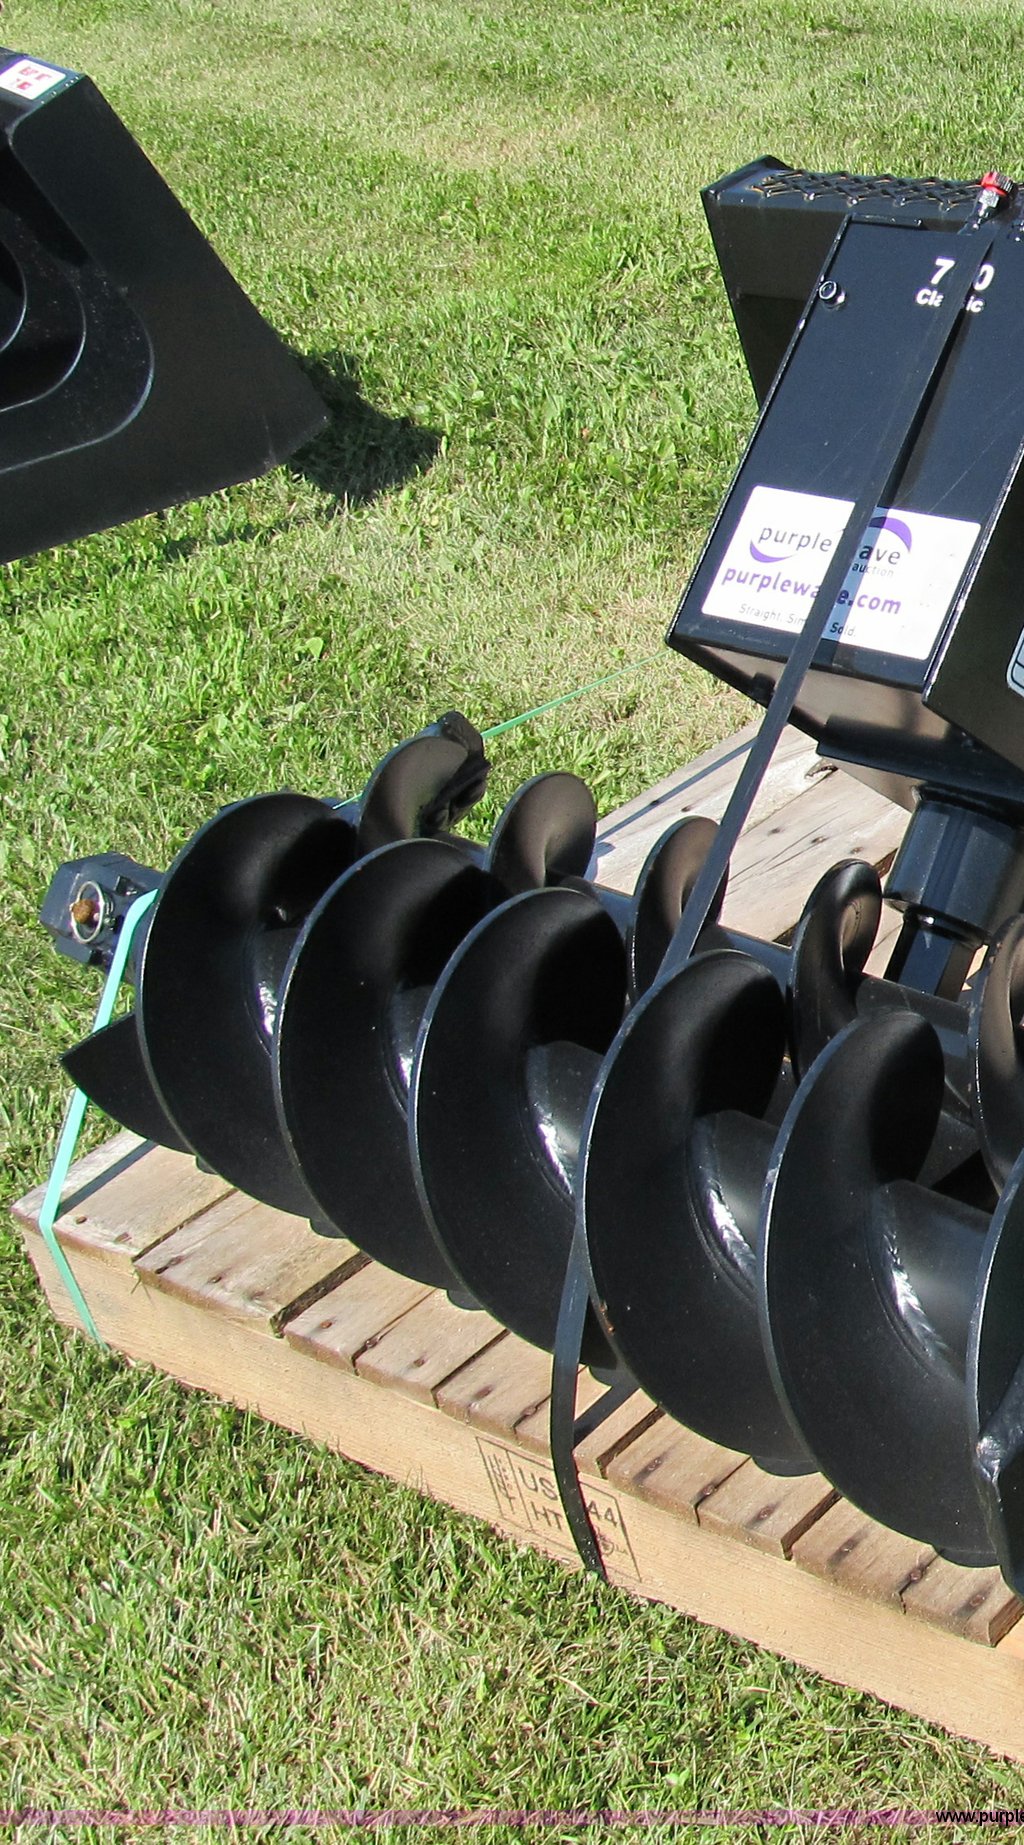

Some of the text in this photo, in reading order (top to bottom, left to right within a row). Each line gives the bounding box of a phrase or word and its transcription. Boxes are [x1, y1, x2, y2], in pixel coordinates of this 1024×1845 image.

[930, 257, 995, 291] 70
[915, 288, 984, 313] Claic
[757, 524, 902, 565] purple ave
[721, 566, 902, 615] purplewae.com
[530, 1501, 562, 1530] HT
